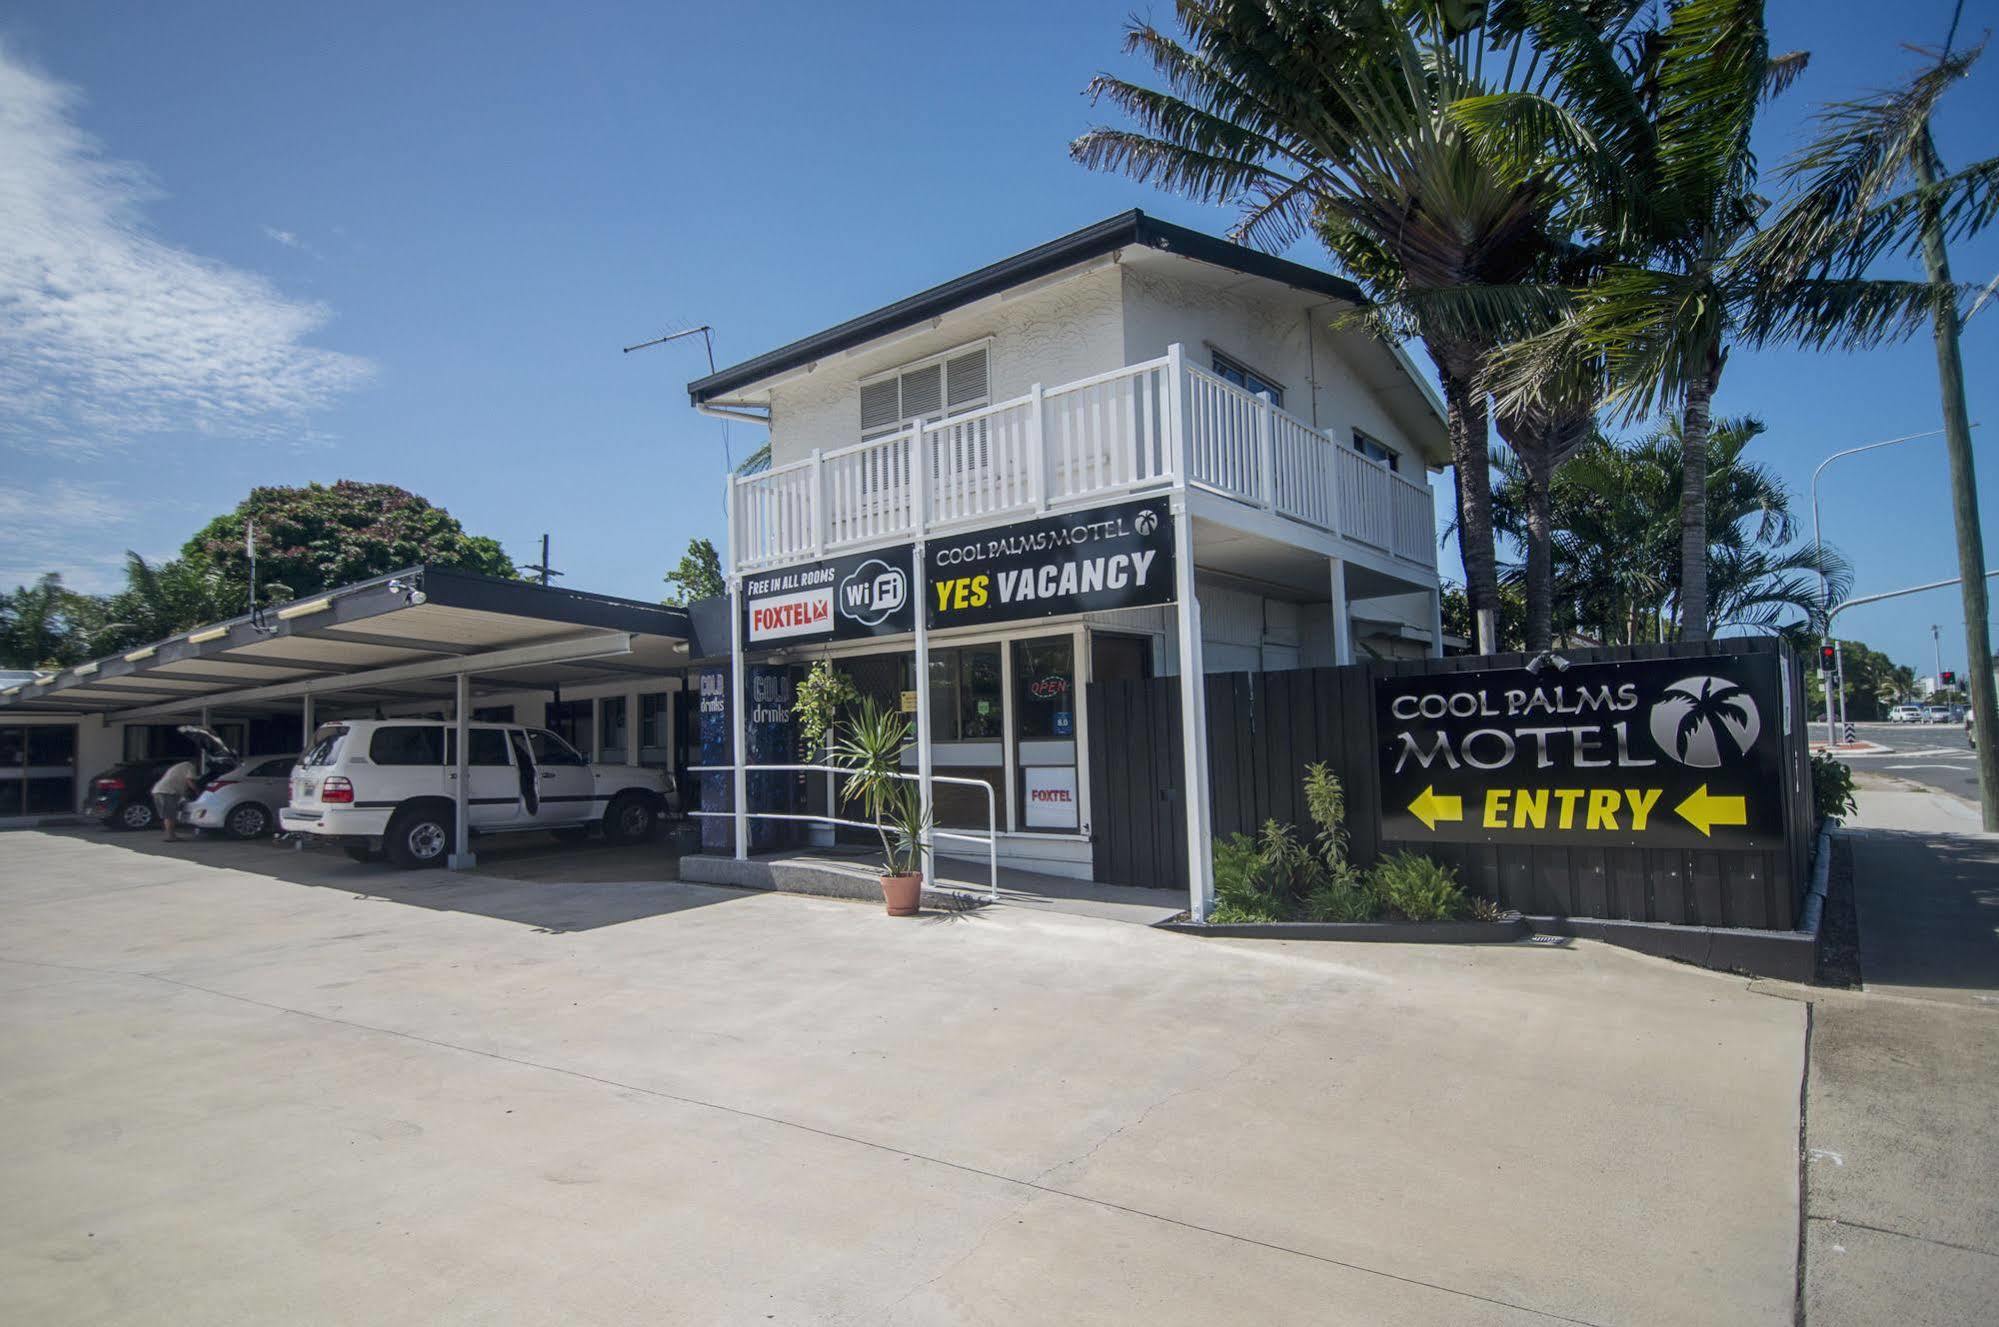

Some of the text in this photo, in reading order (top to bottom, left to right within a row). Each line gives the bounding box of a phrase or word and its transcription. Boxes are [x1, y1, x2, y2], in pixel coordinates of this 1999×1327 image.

[936, 518, 1130, 567] COOL PALMS MOTEL
[748, 568, 835, 596] FREE IN ALL ROOMS
[936, 550, 1156, 612] YES VACANCY
[754, 601, 812, 632] FOXTEL
[1031, 680, 1067, 694] OPEN
[1391, 683, 1639, 719] COOL PALMS
[701, 697, 724, 713] drinks
[753, 703, 790, 723] drinks
[1394, 721, 1656, 774] MOTEL
[1032, 789, 1072, 802] FOXTEL
[1482, 788, 1664, 831] ENTRY
